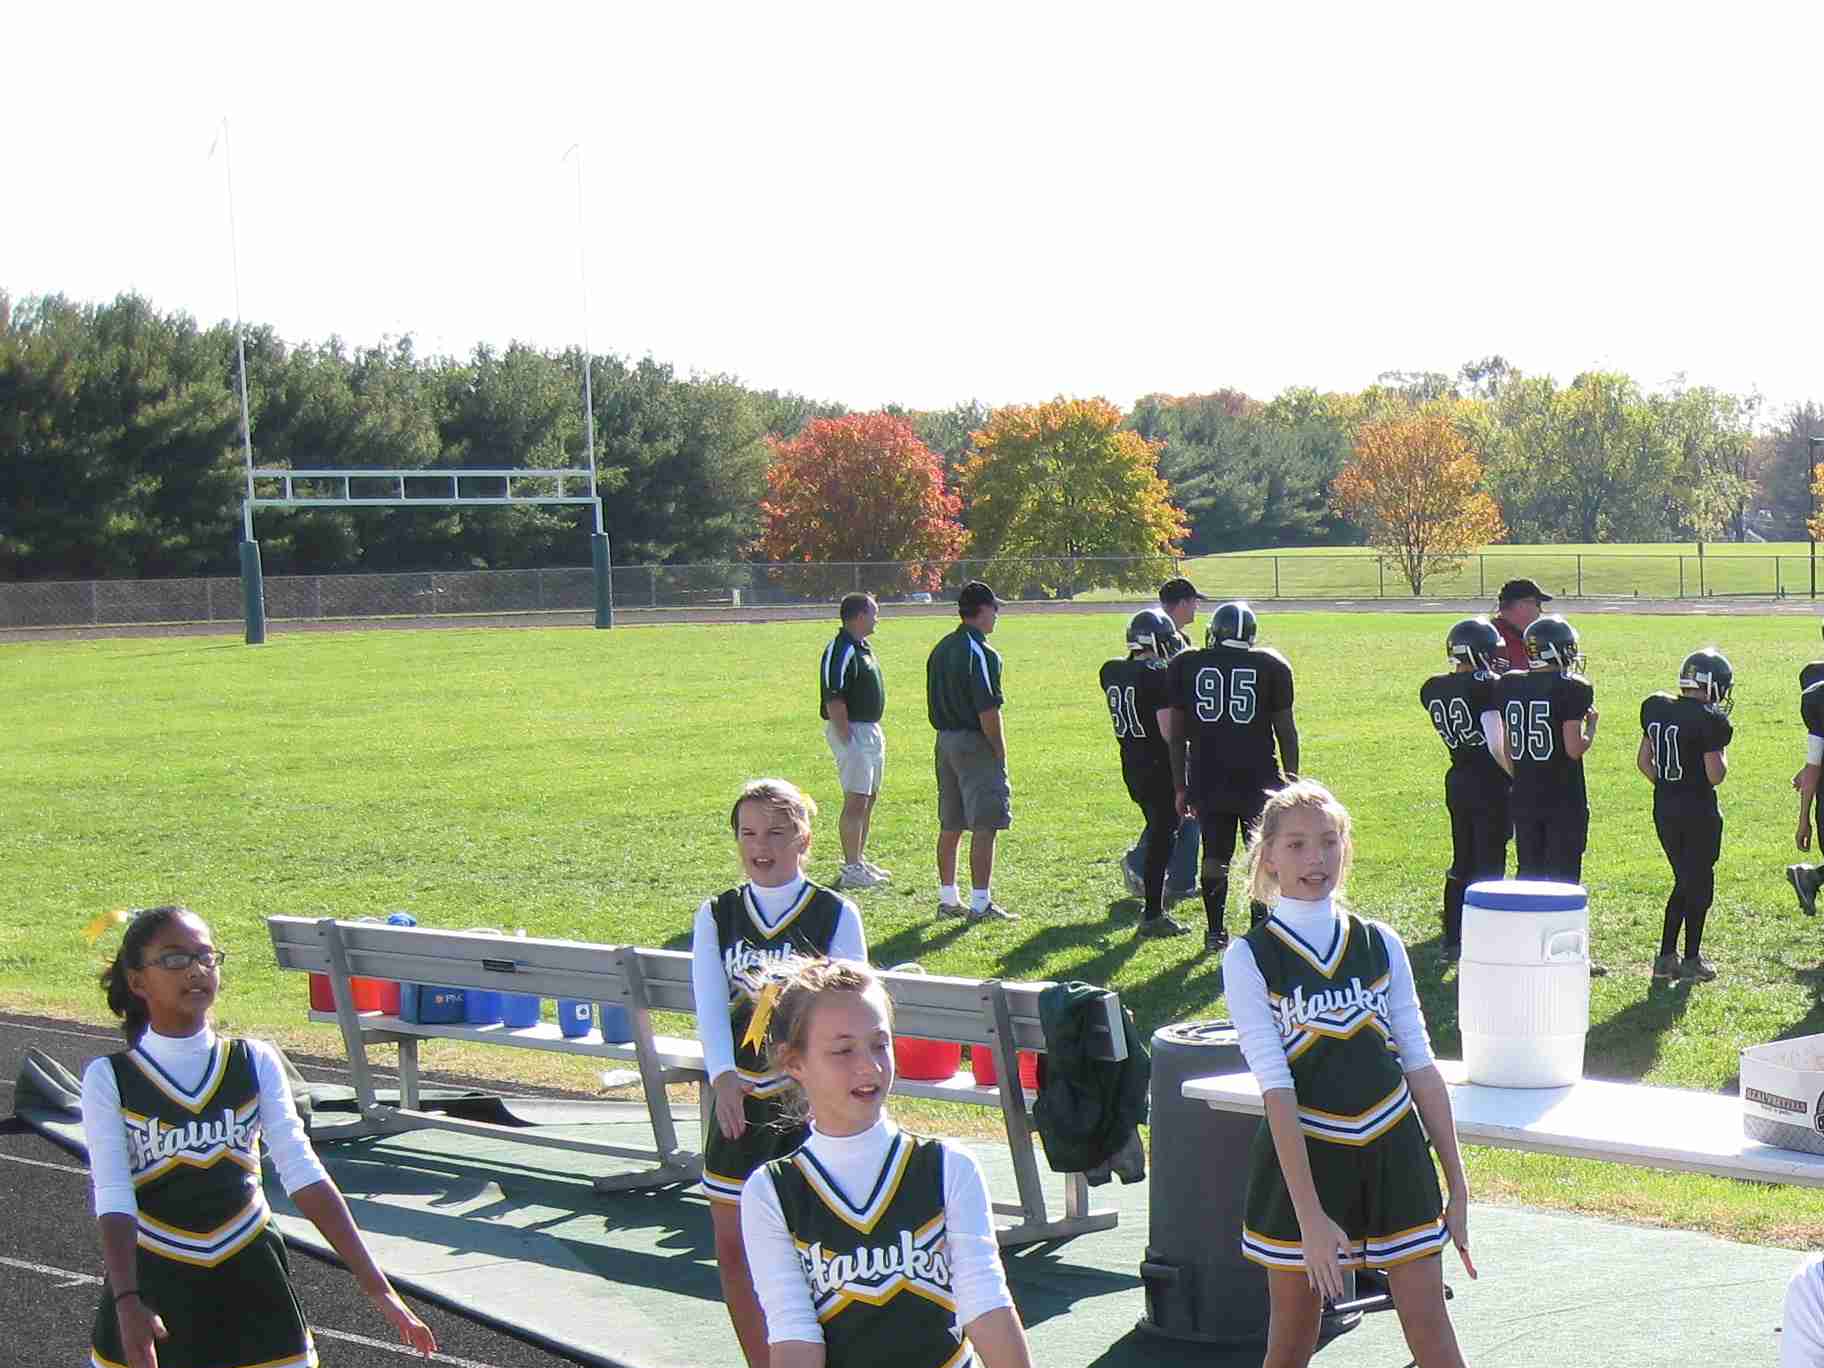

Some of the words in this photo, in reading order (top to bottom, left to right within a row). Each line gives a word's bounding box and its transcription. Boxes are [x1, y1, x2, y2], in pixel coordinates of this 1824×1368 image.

[1195, 667, 1257, 724] 95
[1504, 700, 1553, 761] 85
[800, 1229, 951, 1297] Hawks
